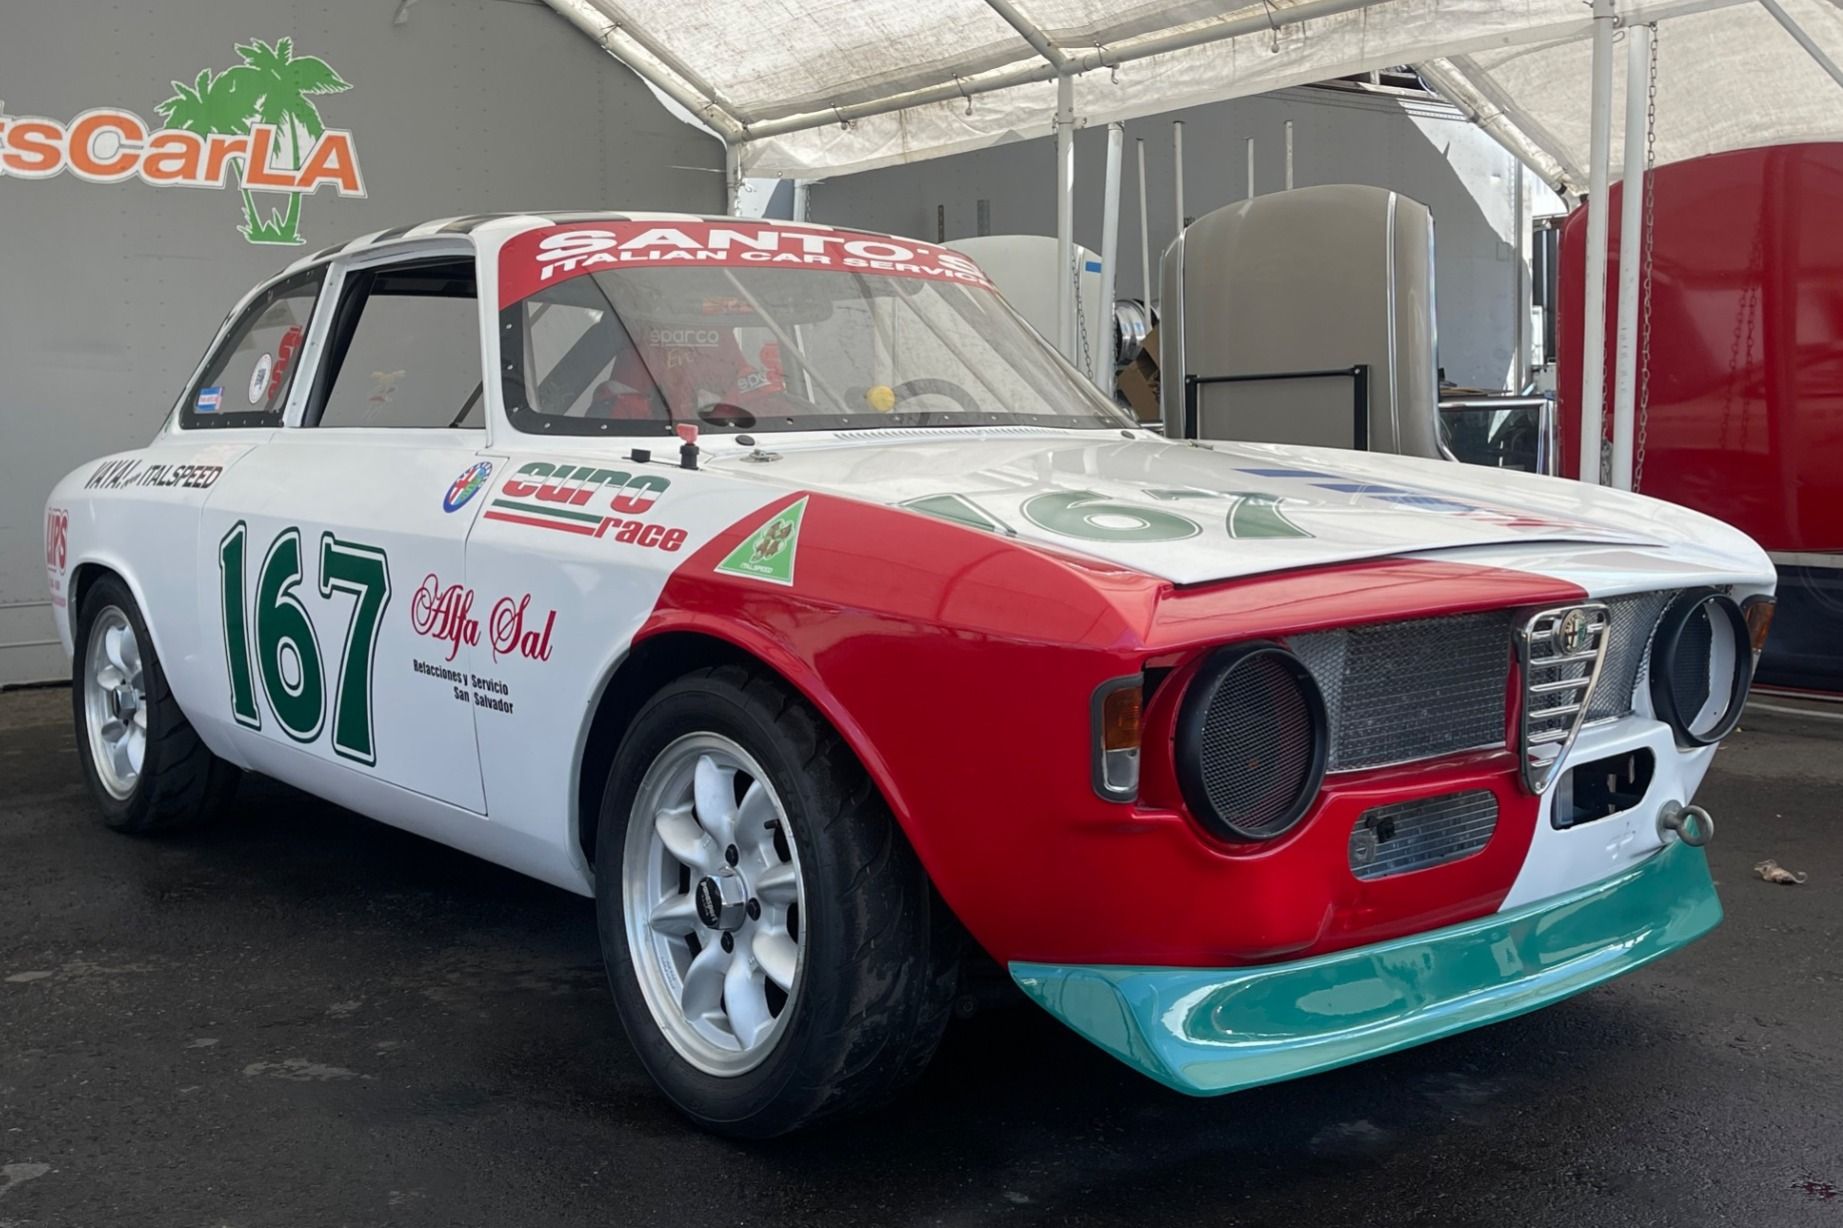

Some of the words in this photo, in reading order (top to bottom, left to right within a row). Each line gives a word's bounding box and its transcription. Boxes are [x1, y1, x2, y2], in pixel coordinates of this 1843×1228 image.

[536, 228, 985, 280] SANTO'S
[540, 250, 728, 280] ITALIAN
[740, 250, 831, 265] CAR
[136, 464, 223, 489] ITALSPEED
[502, 462, 671, 514] euro
[594, 516, 688, 552] race
[411, 573, 481, 662] Alfa
[489, 593, 556, 664] Sal
[219, 519, 392, 768] 167
[453, 686, 470, 702] San
[473, 692, 514, 714] Salvador
[471, 674, 509, 696] Servicio
